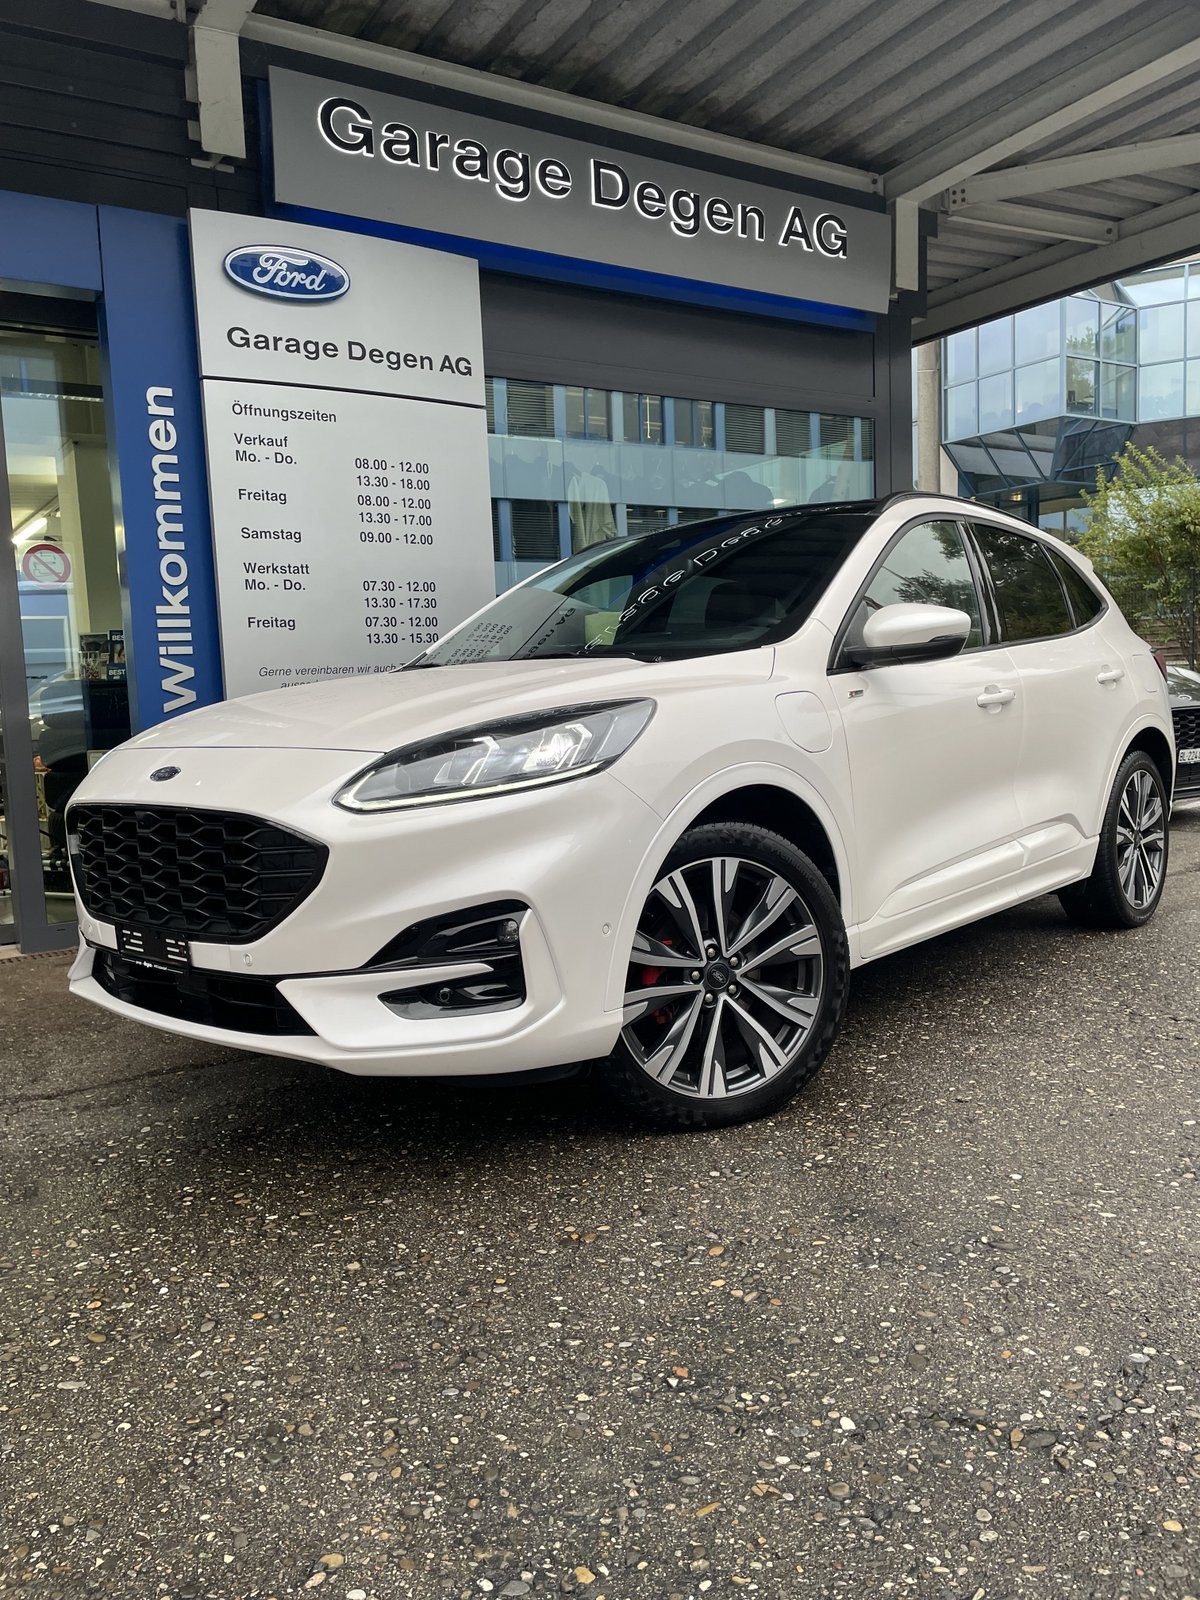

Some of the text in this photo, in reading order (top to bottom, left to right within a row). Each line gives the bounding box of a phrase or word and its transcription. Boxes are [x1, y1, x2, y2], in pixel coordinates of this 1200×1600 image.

[317, 96, 849, 260] Garage Degen AG
[252, 252, 326, 292] Ford
[226, 326, 473, 377] Garage Degen AG
[231, 399, 337, 423] Öffnungszeiten
[233, 432, 288, 448] Verkauf
[235, 449, 261, 463] Mo.
[274, 451, 297, 465] Do.
[354, 457, 388, 471] 08.00
[398, 461, 429, 475] 12.00
[356, 474, 389, 488] 13.30
[399, 478, 430, 491] 18.00
[238, 488, 287, 505] Freitag
[357, 494, 390, 508] 08.00
[401, 497, 432, 510] 12.00
[358, 511, 391, 525] 13.30
[402, 514, 433, 527] 17.00
[240, 526, 302, 544] Samstag
[359, 531, 392, 544] 09.00
[403, 533, 434, 546] 12.00
[146, 385, 198, 713] Willkommen
[242, 561, 310, 575] Werkstatt
[244, 578, 270, 591] Mo.
[283, 578, 306, 591] Do.
[362, 580, 395, 592] 07.30
[406, 581, 436, 593] 12.00
[364, 597, 396, 609] 13.30
[407, 597, 437, 609] 17.30
[247, 616, 296, 631] Freitag
[364, 616, 398, 628] 07.30
[408, 616, 438, 628] 12.00
[366, 632, 399, 645] 13.30
[409, 632, 440, 644] 15.30
[258, 666, 292, 677] Gerne
[294, 665, 355, 676] vereinbaren
[356, 663, 372, 674] wir
